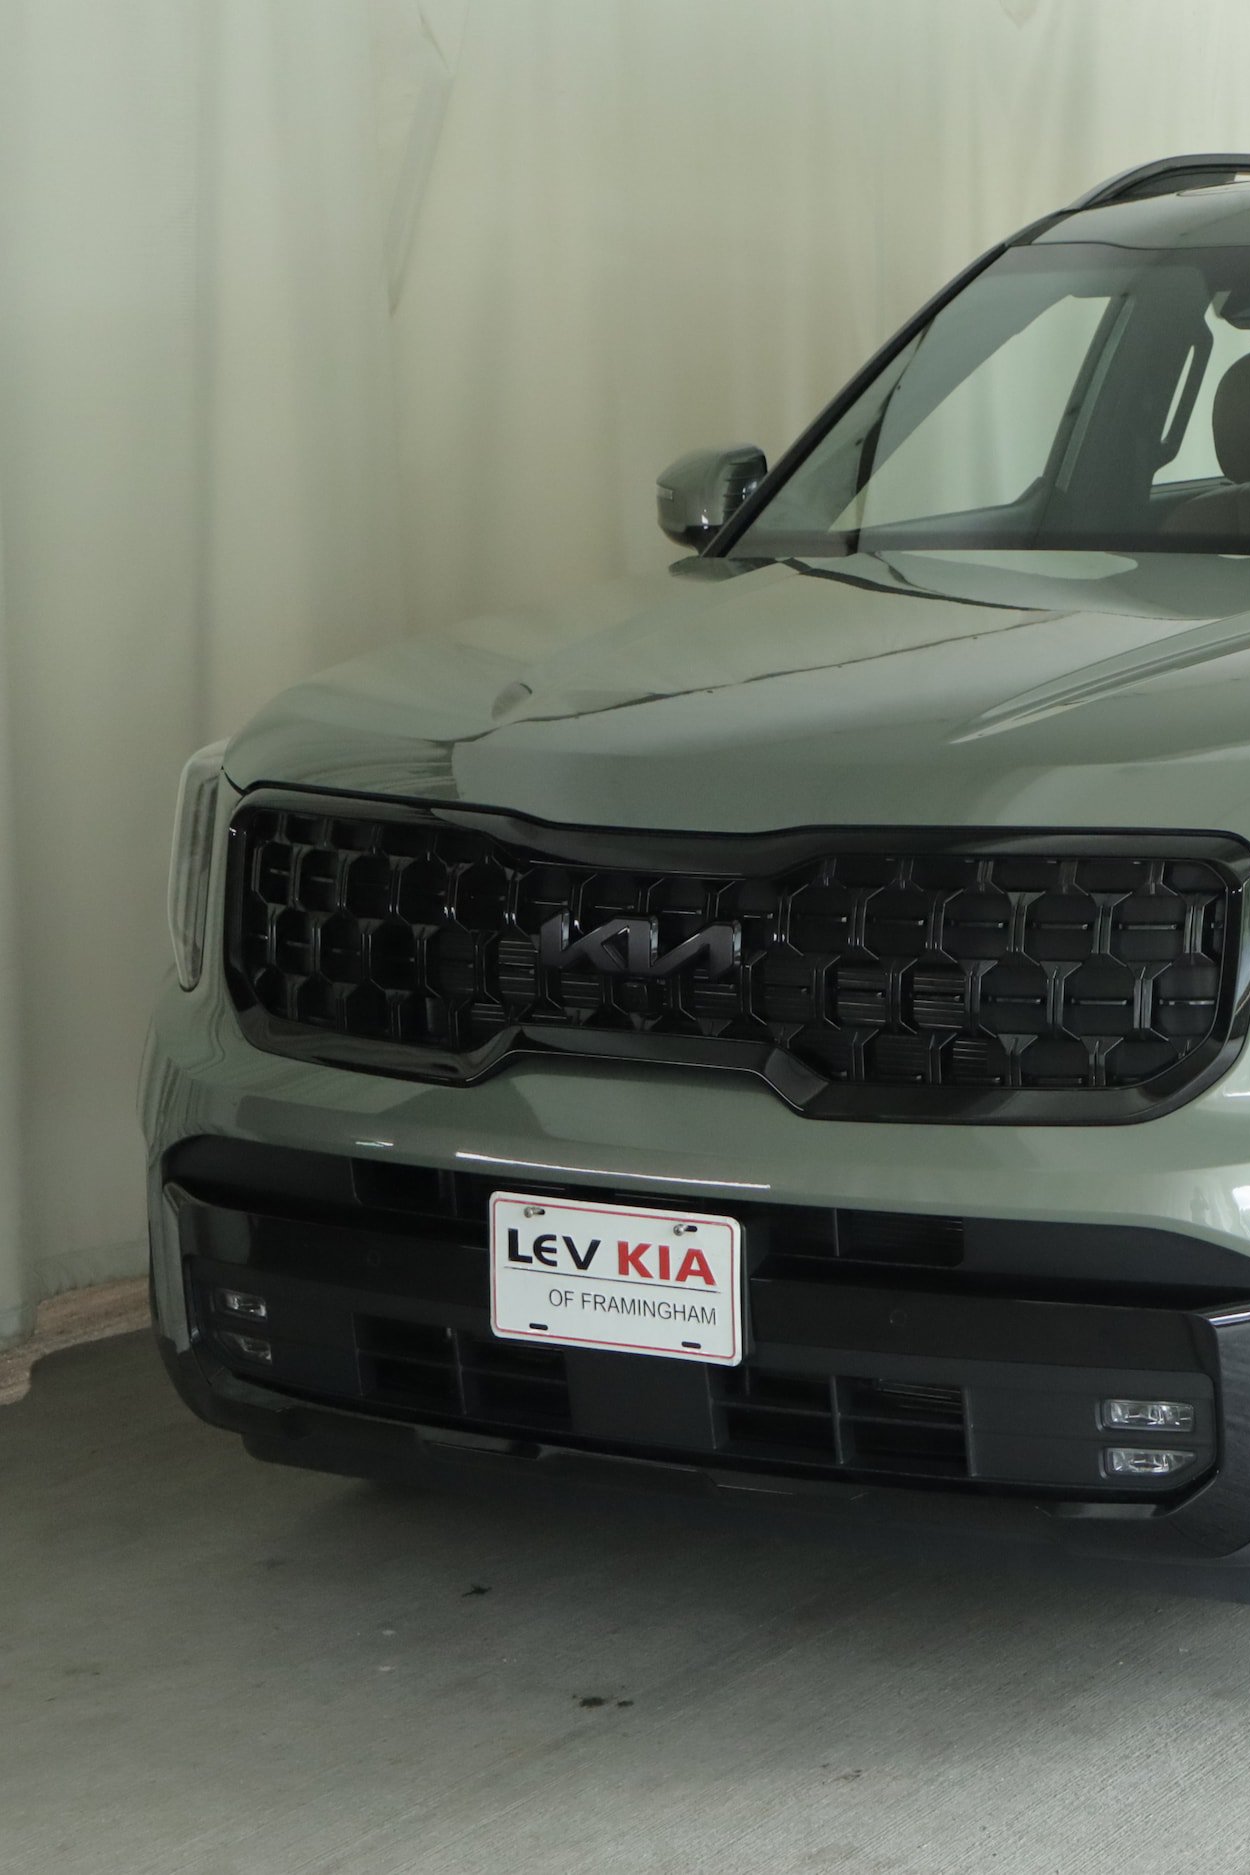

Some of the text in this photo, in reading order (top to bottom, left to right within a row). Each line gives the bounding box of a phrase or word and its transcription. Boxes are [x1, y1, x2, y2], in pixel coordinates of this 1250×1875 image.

[507, 1228, 717, 1286] LEV KIA
[548, 1288, 717, 1326] OF FRAMINGHAM
